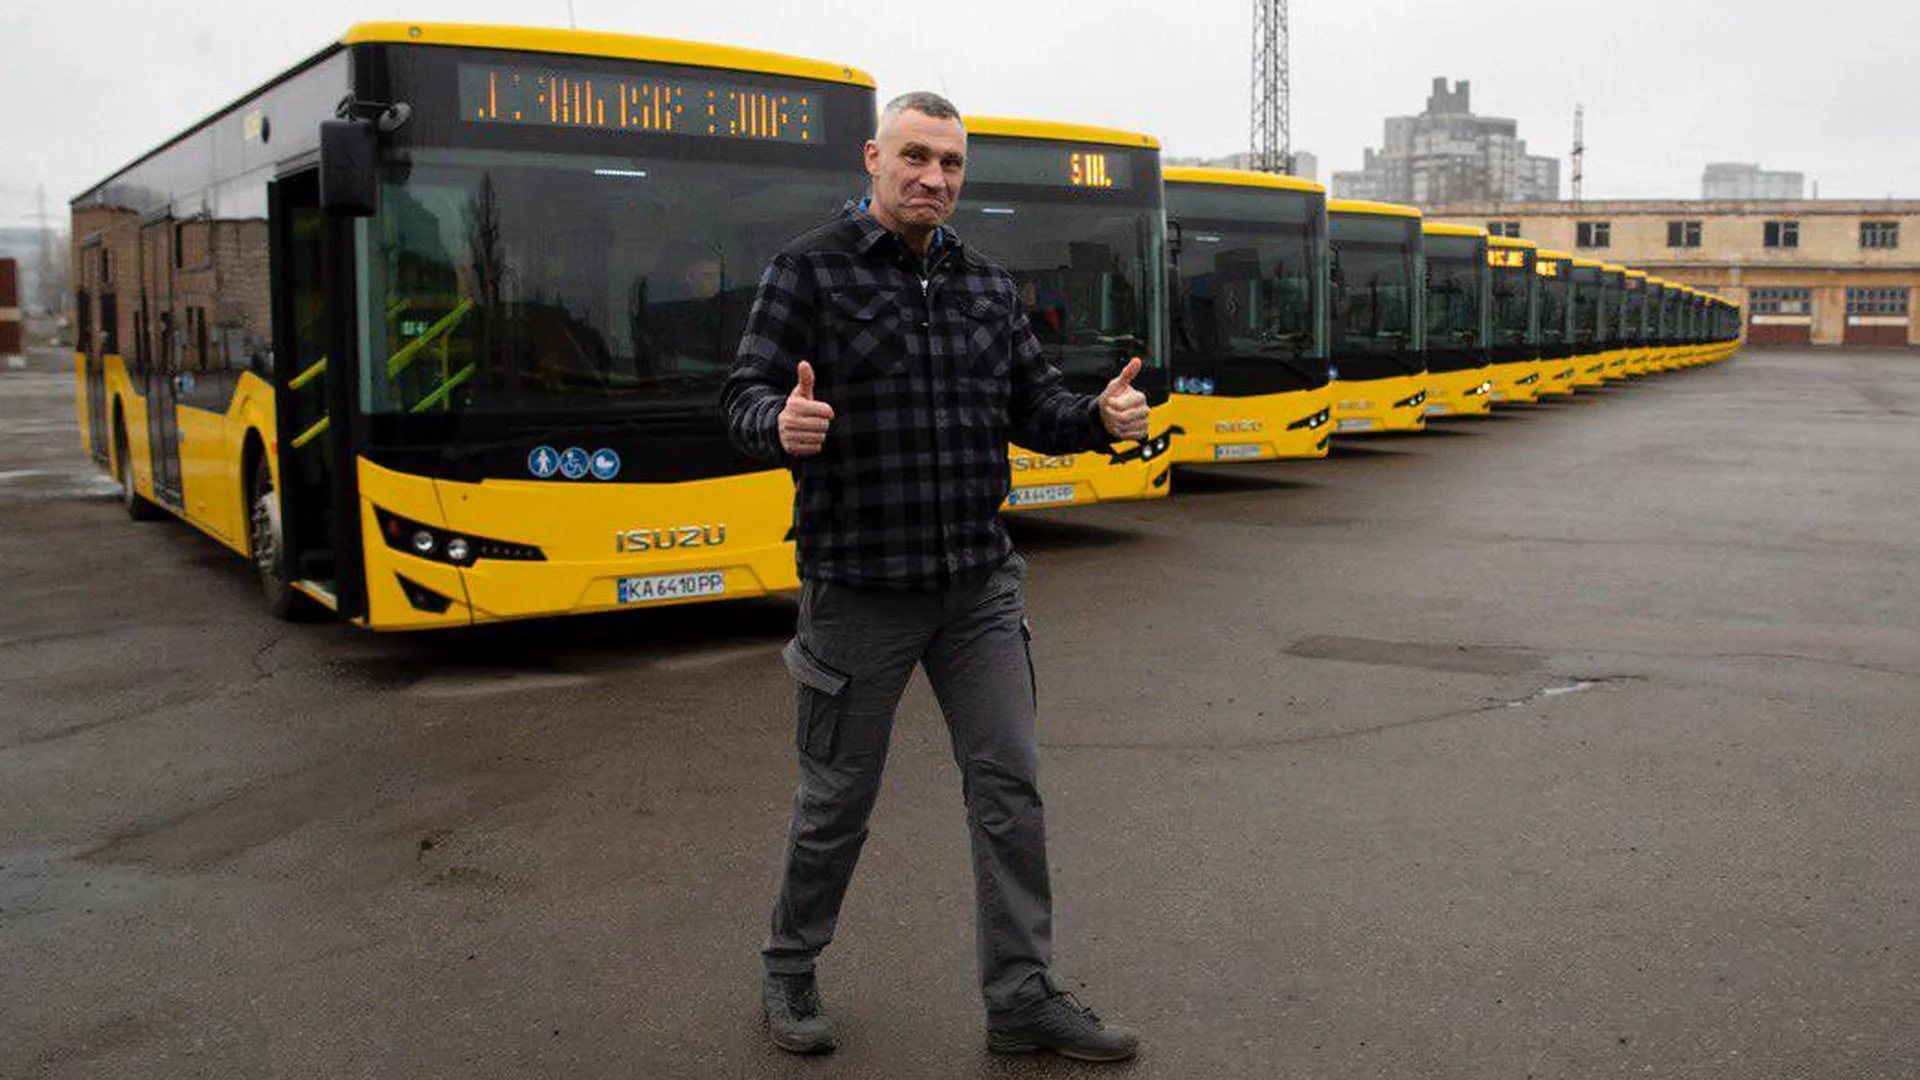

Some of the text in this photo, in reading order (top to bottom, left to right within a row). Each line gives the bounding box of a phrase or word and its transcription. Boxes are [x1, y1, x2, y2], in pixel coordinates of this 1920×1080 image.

[616, 523, 727, 553] ISUZU
[628, 574, 723, 599] KA 6410 PP
